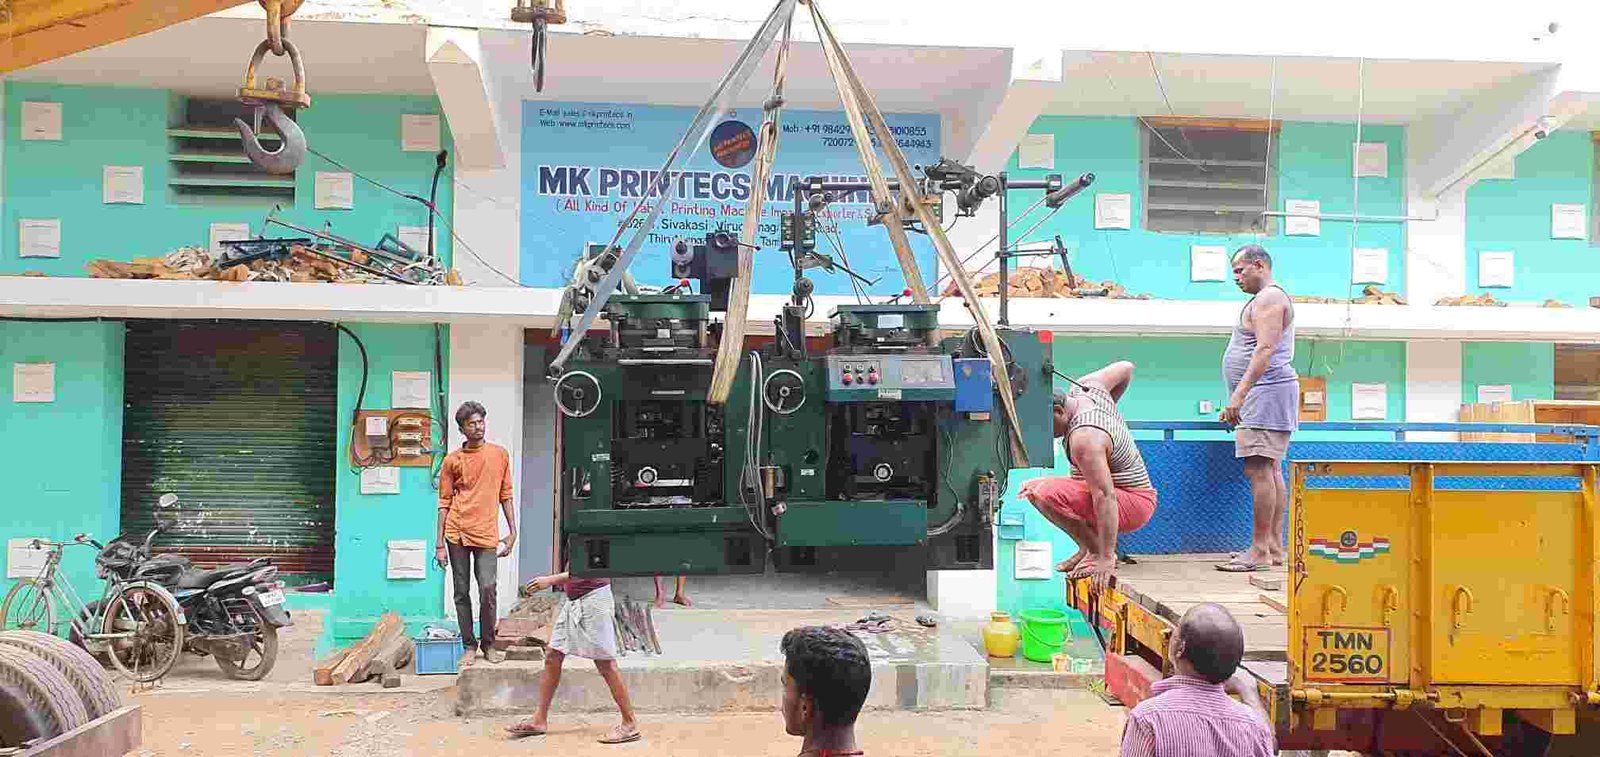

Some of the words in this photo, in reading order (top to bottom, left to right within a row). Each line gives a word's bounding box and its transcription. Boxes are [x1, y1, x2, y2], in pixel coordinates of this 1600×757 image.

[539, 166, 591, 196] MK
[599, 168, 751, 200] PRINTECS
[585, 201, 608, 213] Kind
[671, 204, 715, 218] Printing
[661, 218, 708, 231] Sivakasi
[1317, 631, 1373, 651] TMN
[1312, 652, 1383, 675] 2560
